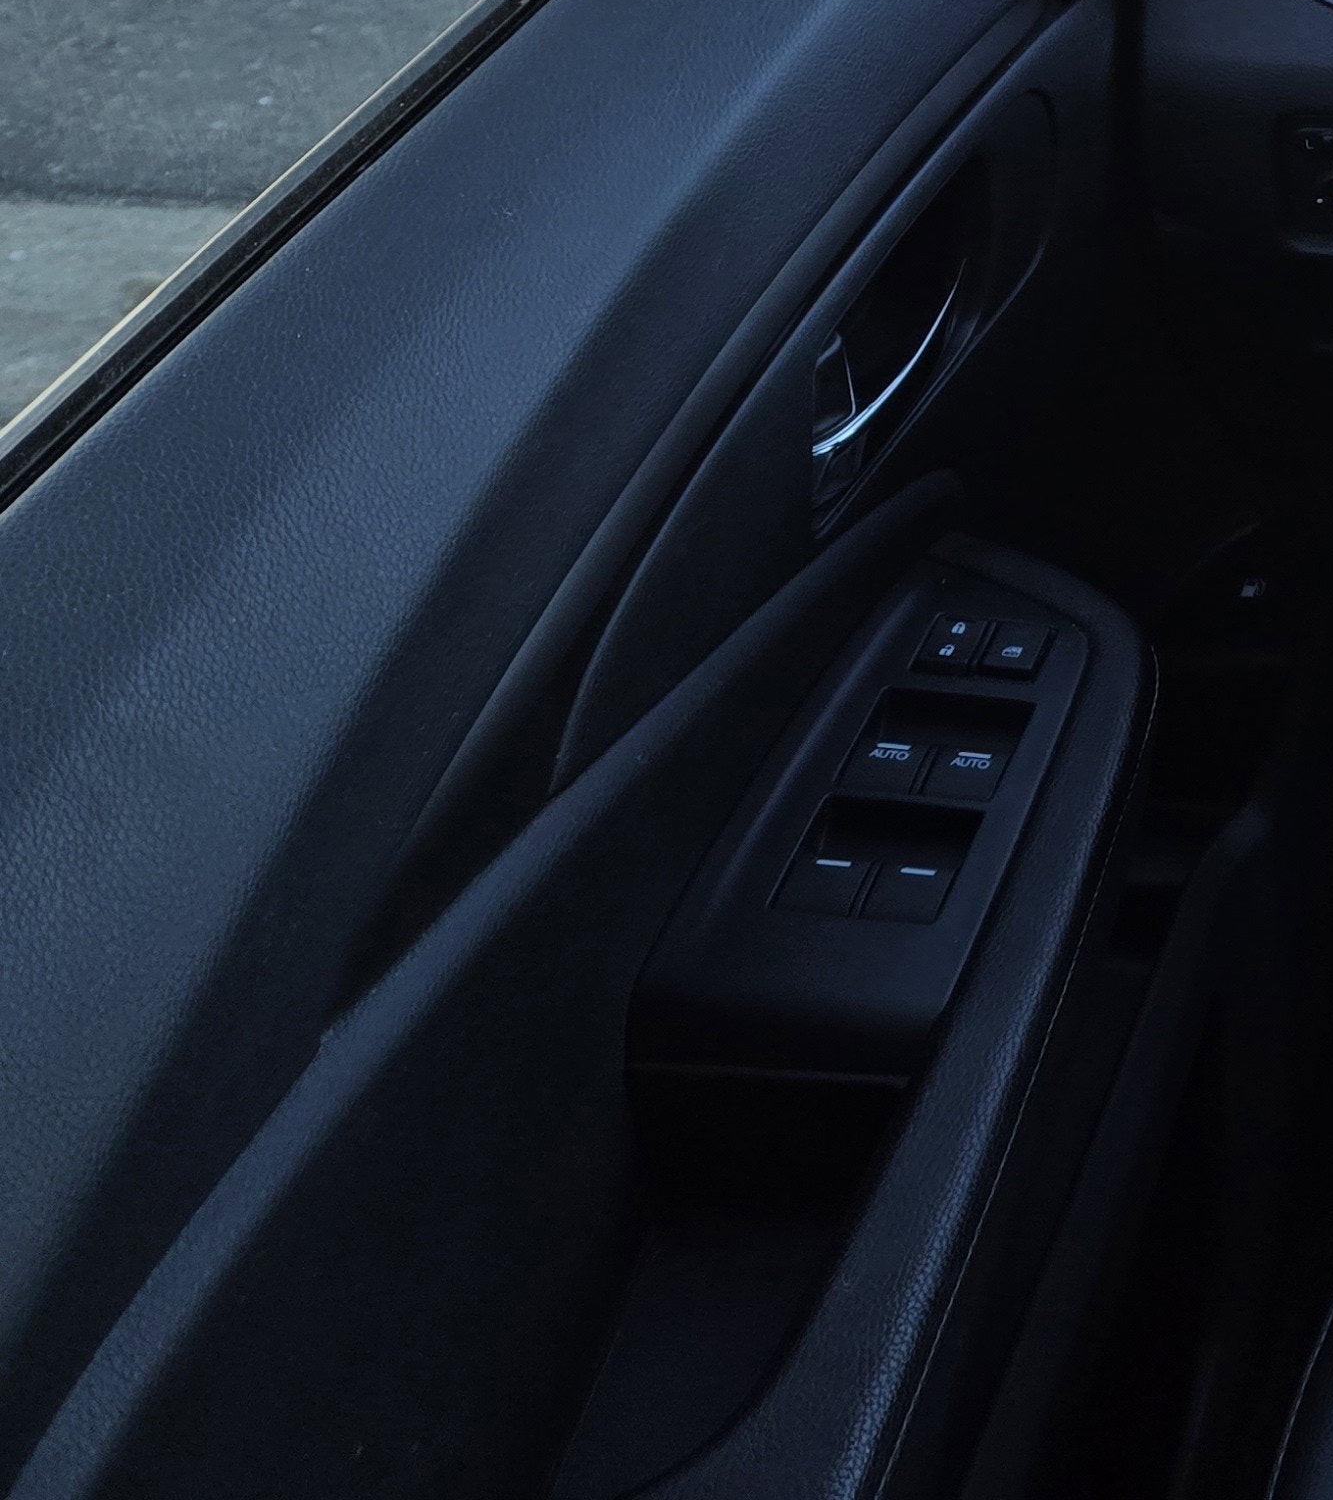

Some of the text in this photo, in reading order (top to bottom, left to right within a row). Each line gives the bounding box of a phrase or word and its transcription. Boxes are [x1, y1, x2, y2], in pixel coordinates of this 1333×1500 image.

[1304, 139, 1315, 150] L
[869, 748, 911, 761] AUTO
[950, 757, 992, 770] AUTO
